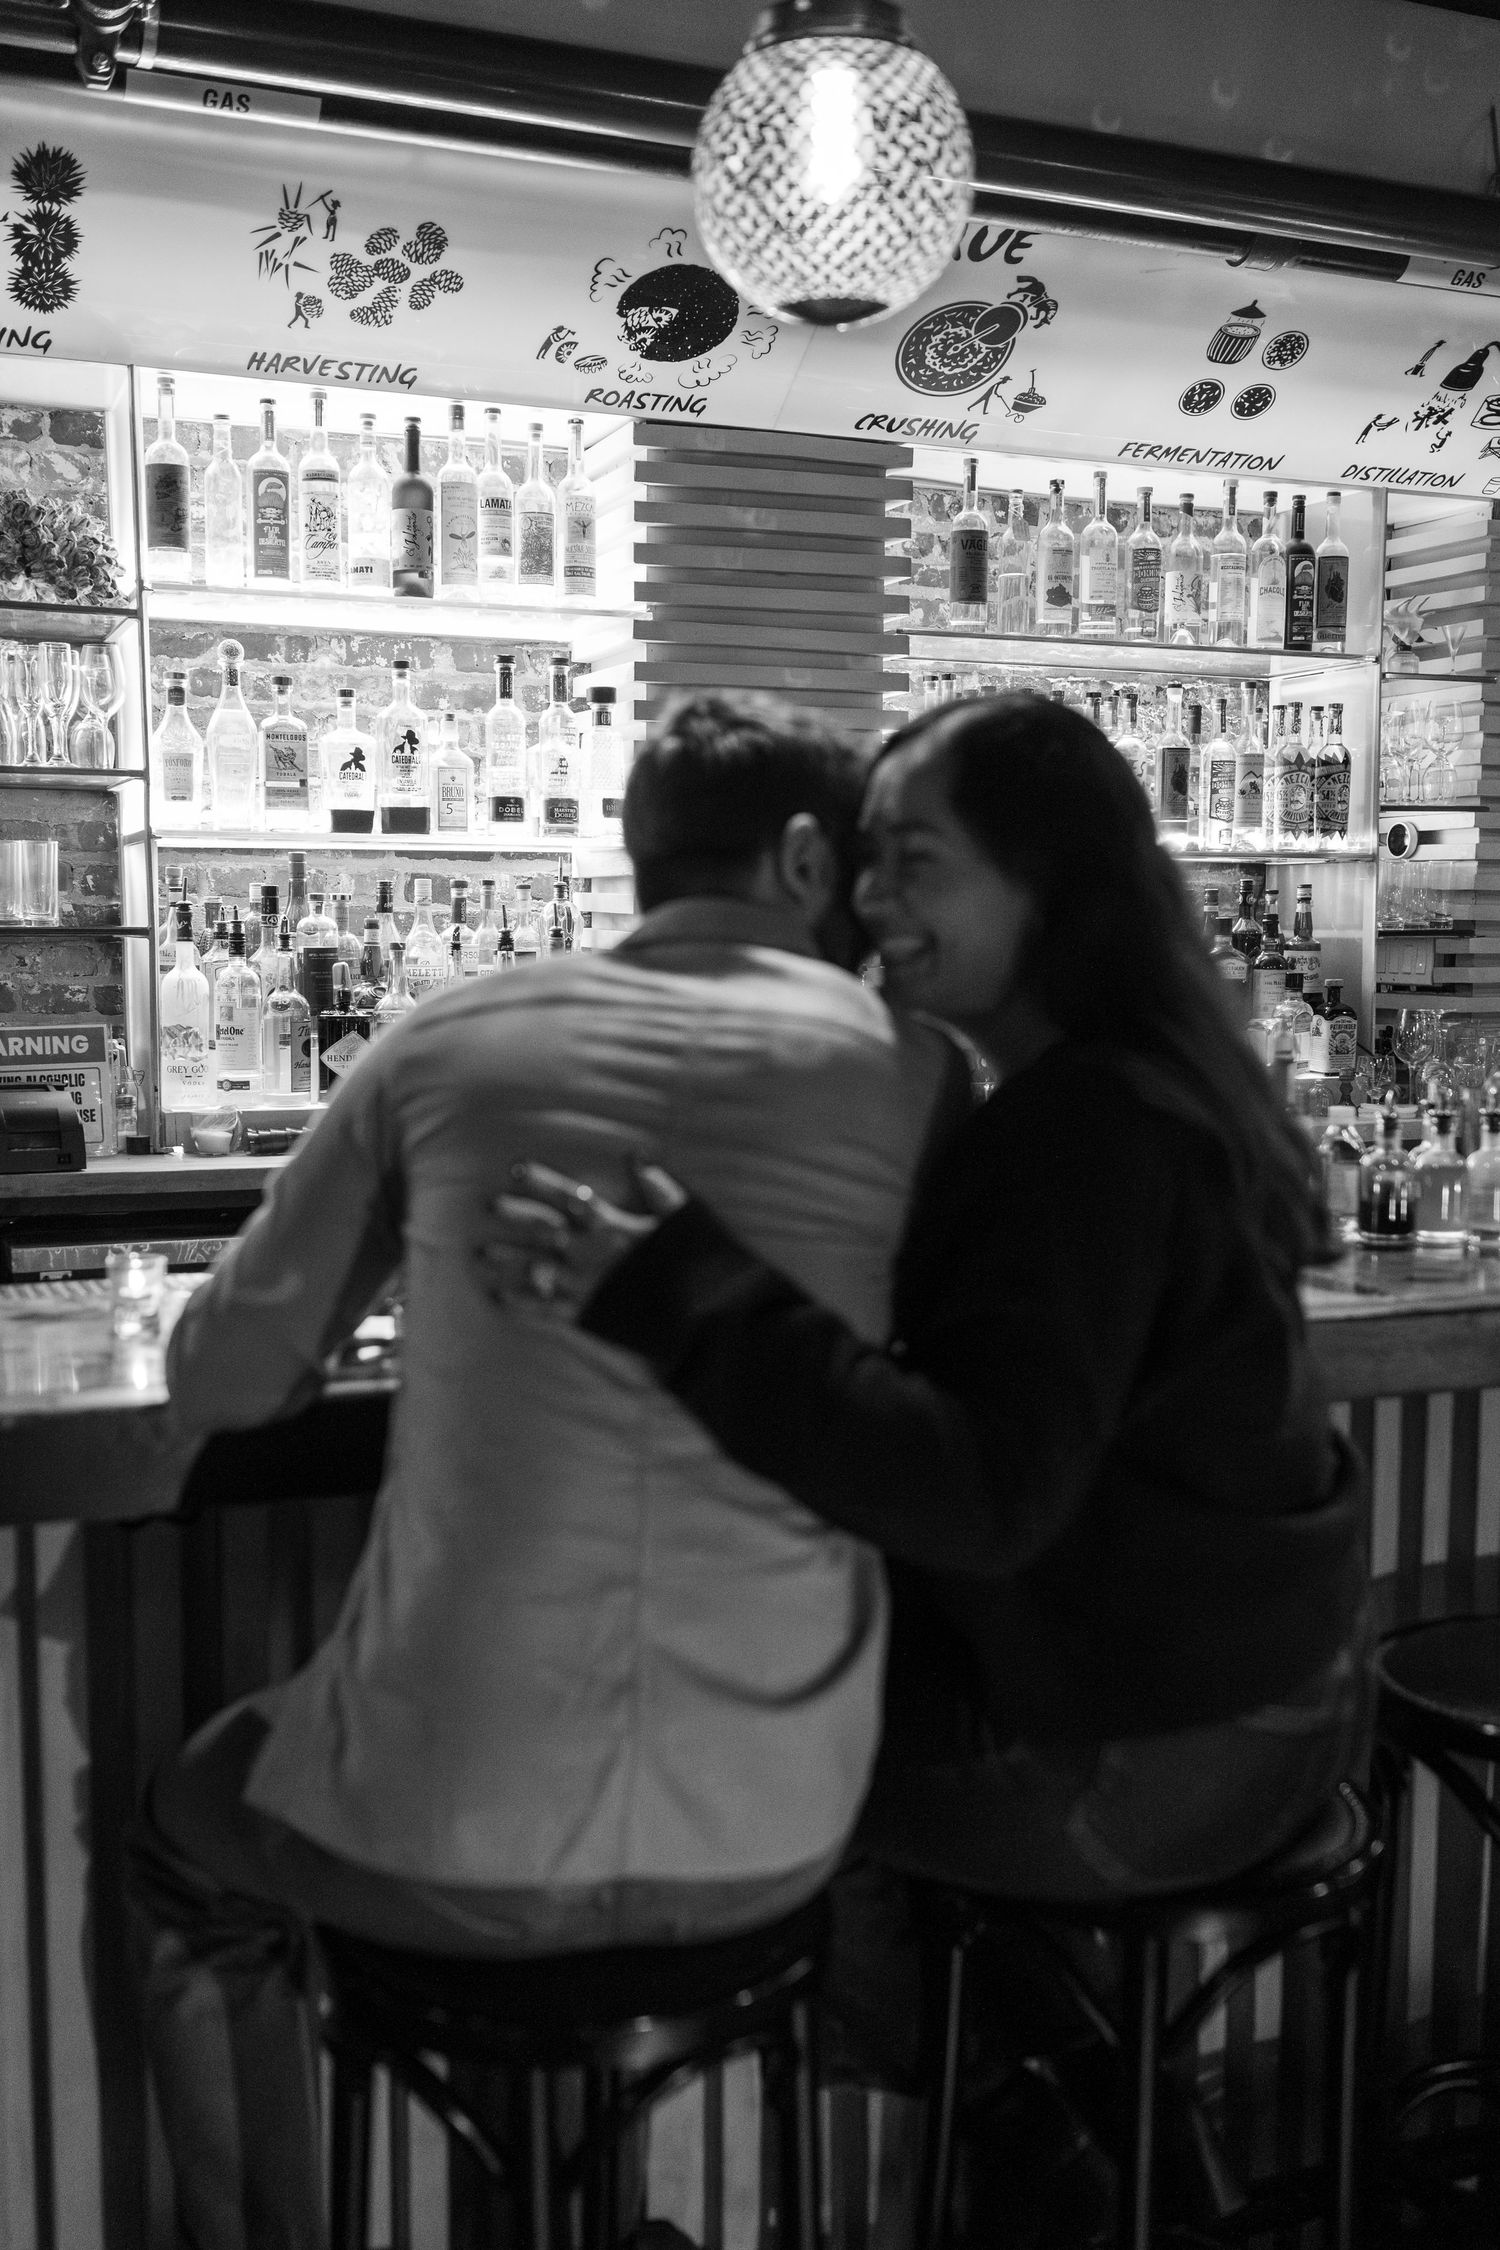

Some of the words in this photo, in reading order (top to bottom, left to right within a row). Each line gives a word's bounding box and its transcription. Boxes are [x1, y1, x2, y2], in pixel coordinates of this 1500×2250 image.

[202, 88, 251, 113] GAS
[1450, 268, 1486, 289] GAS
[247, 351, 418, 389] HARVESTING
[584, 388, 708, 417] ROASTING
[854, 413, 978, 443] CRUSHING
[1118, 442, 1286, 473] FERMENTATION
[1340, 464, 1466, 489] DISTILLATION
[338, 771, 365, 781] CATEDRAL
[442, 786, 464, 798] BRUXO
[446, 803, 453, 815] 5
[167, 1065, 189, 1074] GREY
